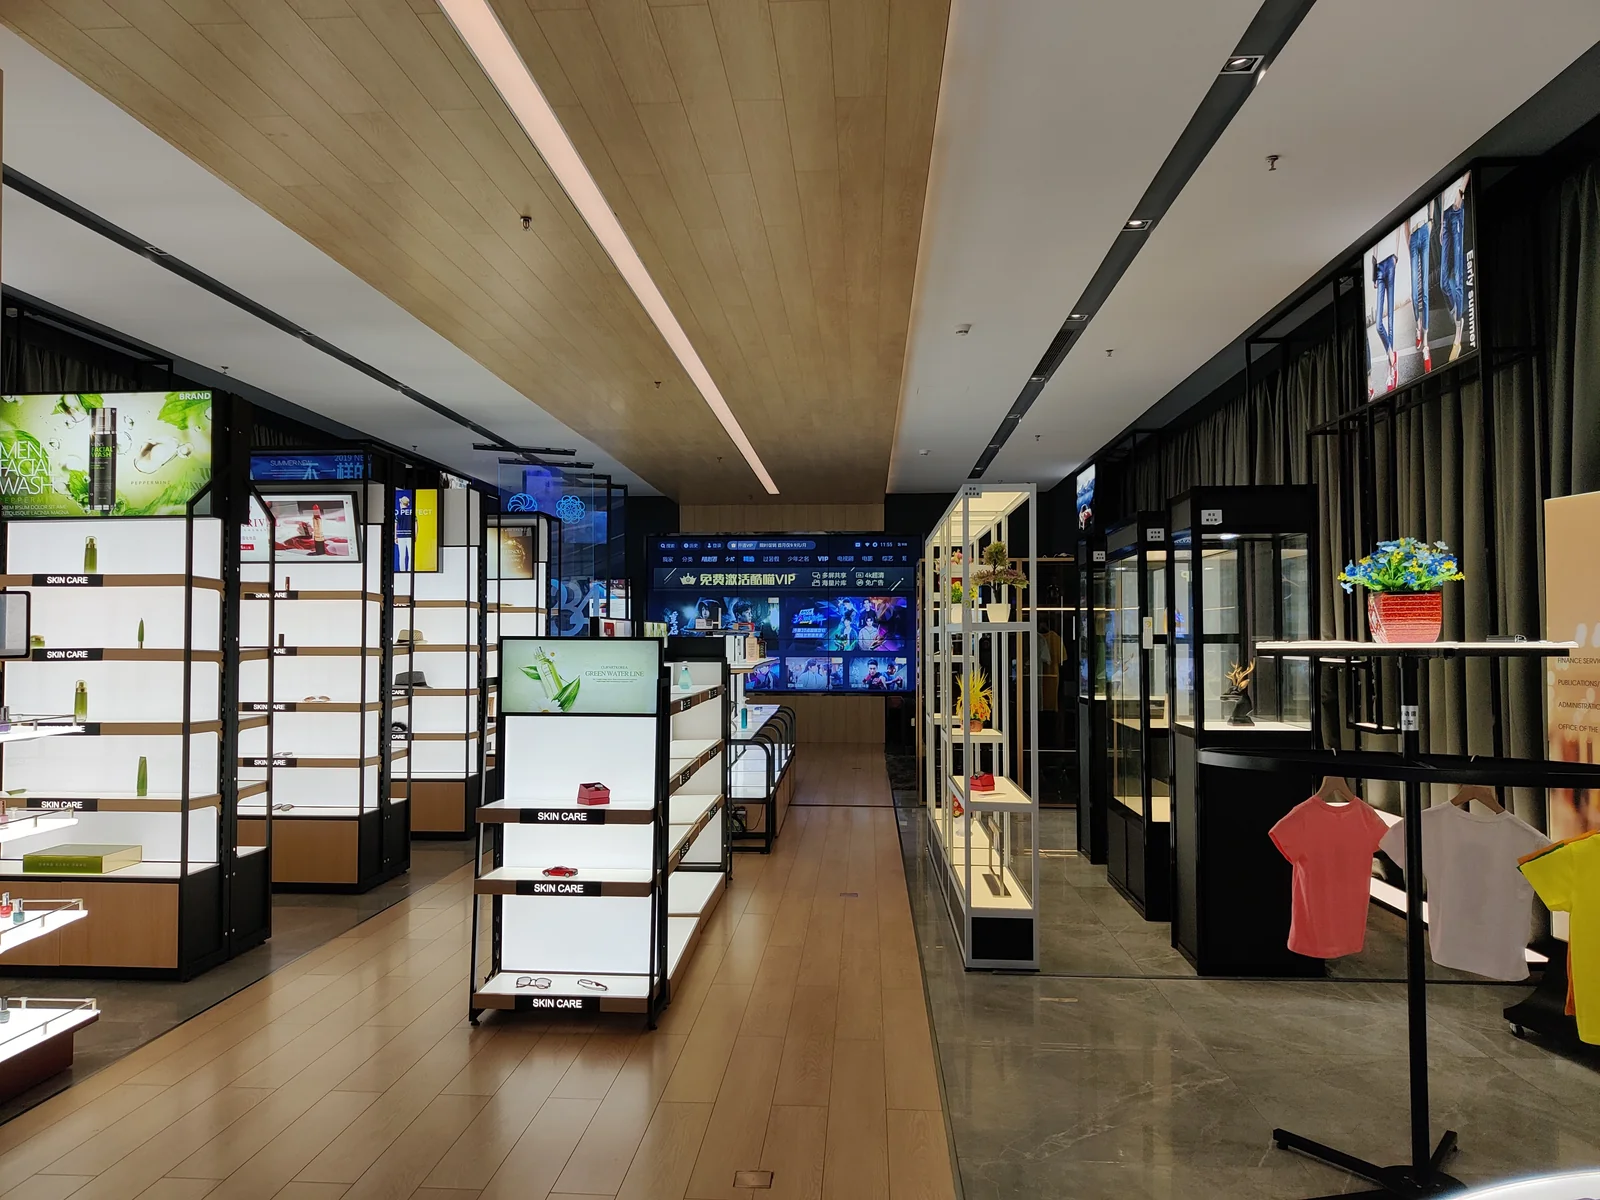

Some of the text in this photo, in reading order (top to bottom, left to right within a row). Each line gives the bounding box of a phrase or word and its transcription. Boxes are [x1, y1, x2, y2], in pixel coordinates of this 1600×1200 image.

[1466, 250, 1476, 348] Early summer
[179, 392, 211, 400] BRAND
[0, 458, 55, 477] FACIAL
[0, 476, 55, 494] WASH
[46, 576, 89, 584] SKIN CARE
[700, 573, 796, 586] 免费激活酷喵VIP
[822, 579, 847, 587] 海量片库
[865, 579, 884, 587] 免广告
[46, 650, 89, 659] SKIN CARE
[1558, 724, 1577, 732] OFFICE
[1579, 724, 1587, 732] OF
[41, 801, 83, 809] SKIN CARE
[537, 811, 588, 822] SKIN CARE
[533, 883, 584, 893] SKIN CARE
[532, 998, 583, 1009] SKIN CARE
